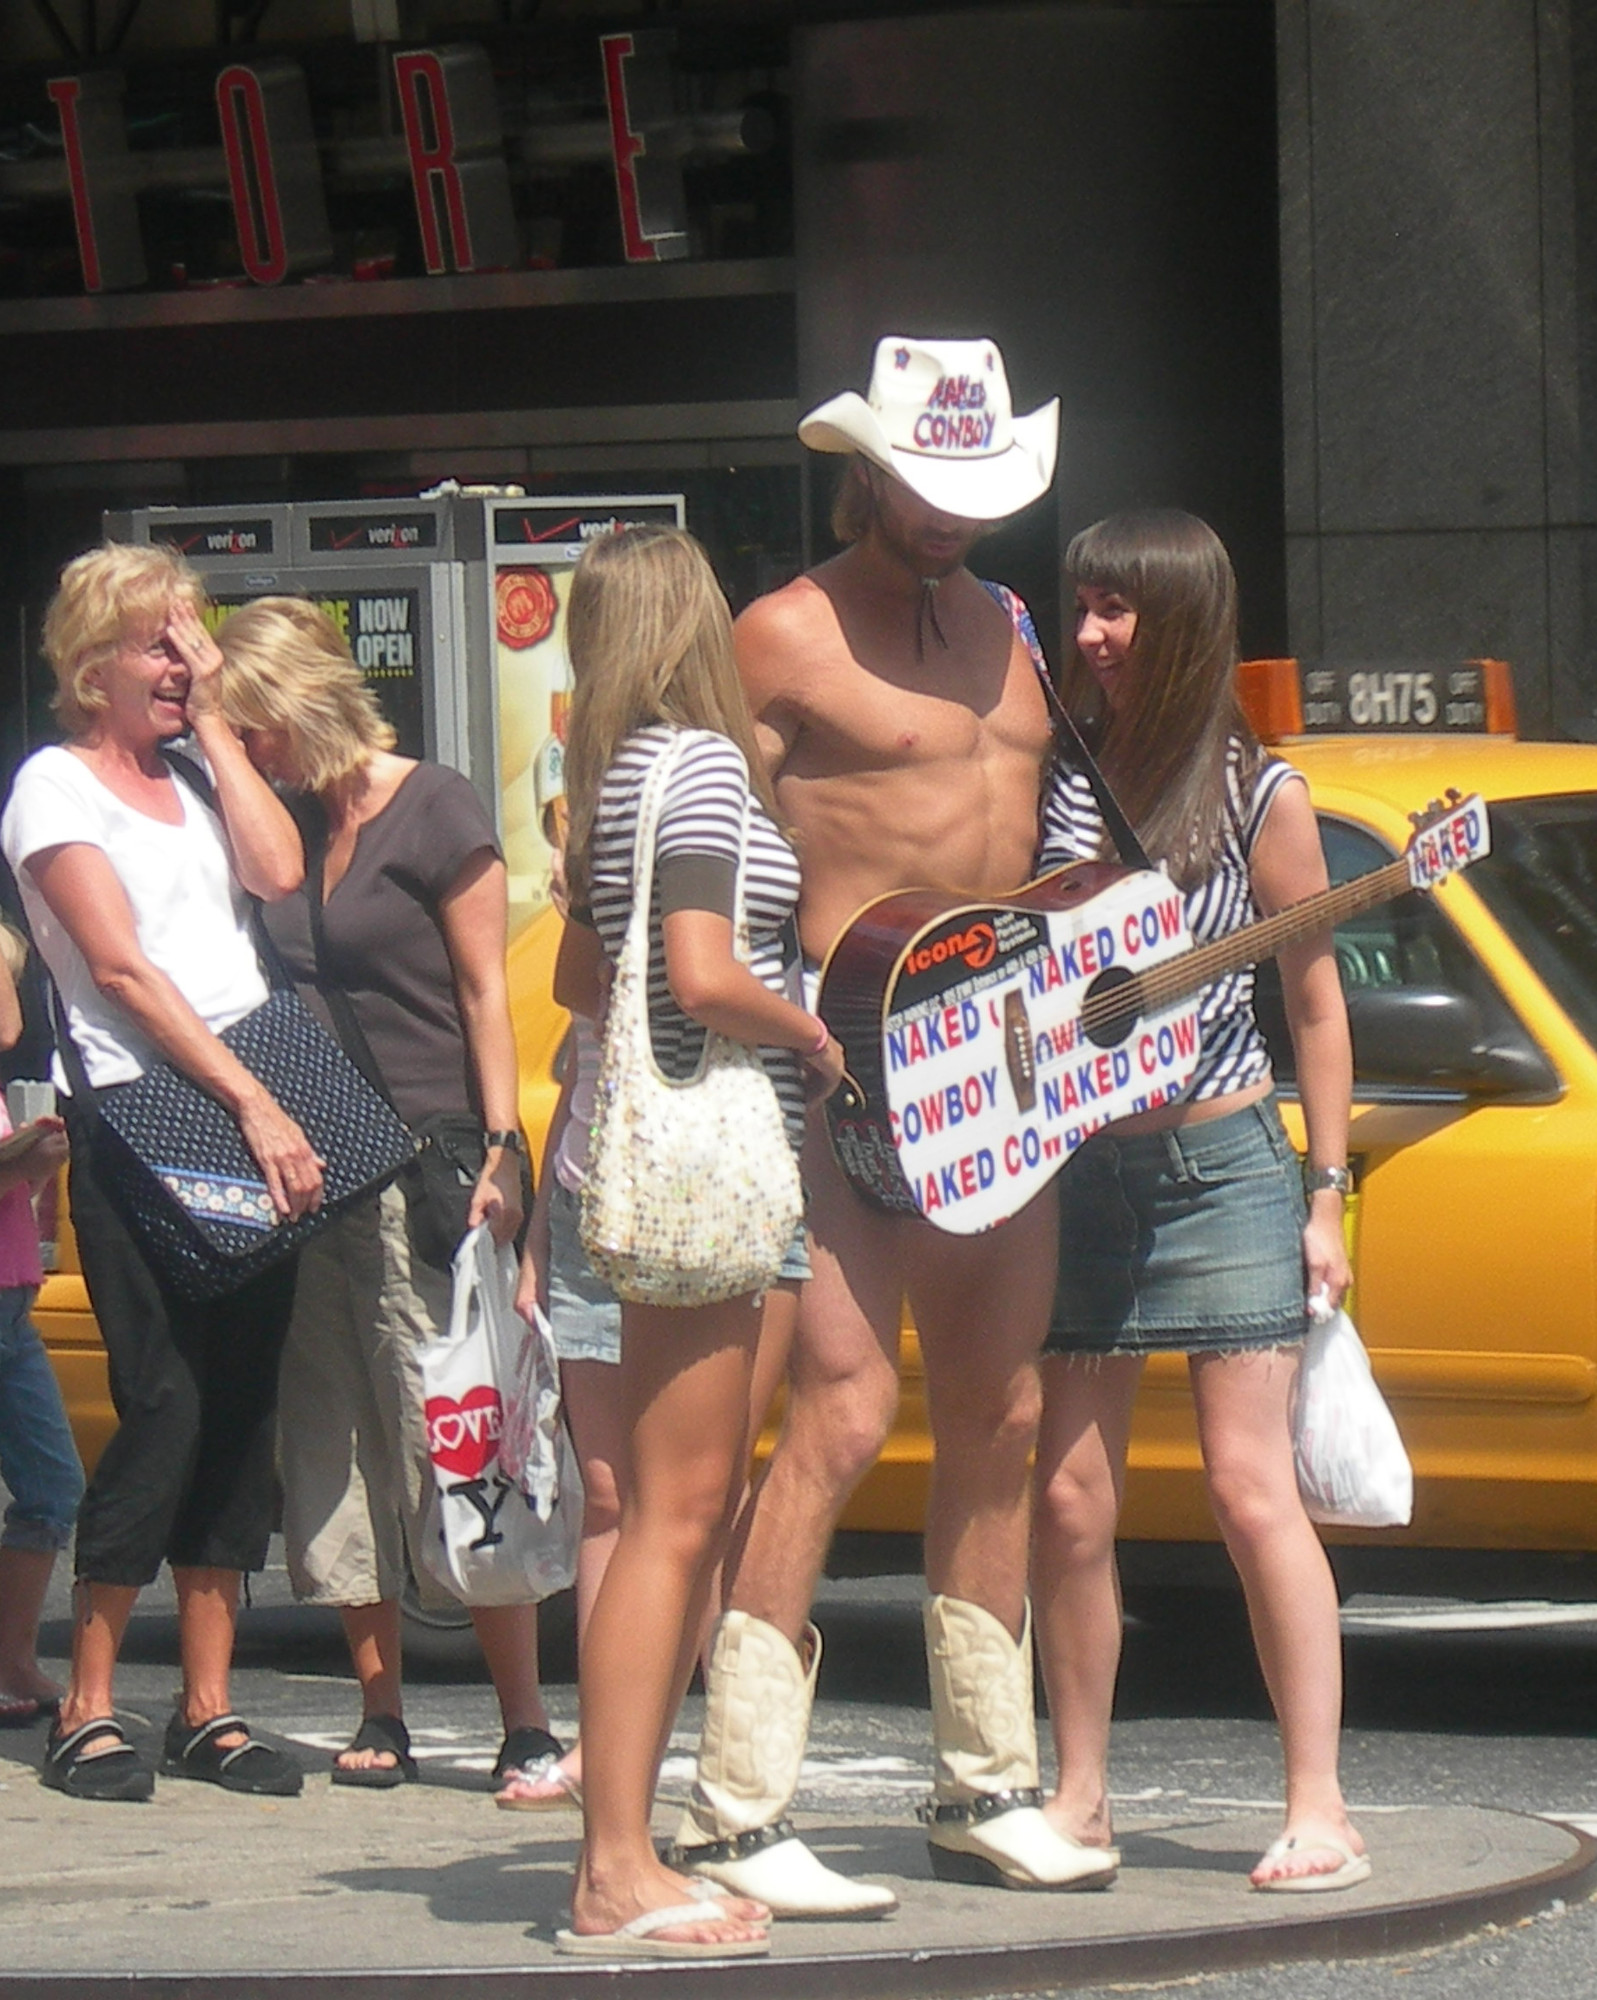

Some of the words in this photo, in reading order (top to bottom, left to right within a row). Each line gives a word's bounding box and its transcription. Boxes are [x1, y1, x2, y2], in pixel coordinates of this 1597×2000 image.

[925, 374, 987, 410] NAKED
[207, 529, 256, 553] verizon
[368, 524, 420, 548] verizon
[358, 597, 409, 633] NOW
[356, 633, 414, 668] OPEN
[1350, 672, 1437, 725] 8H75
[1412, 809, 1480, 884] NAKED
[1029, 925, 1115, 998] NAKED
[887, 999, 981, 1073] NAKED
[887, 1065, 997, 1149] COWBOY
[1043, 1049, 1131, 1120] NAKED
